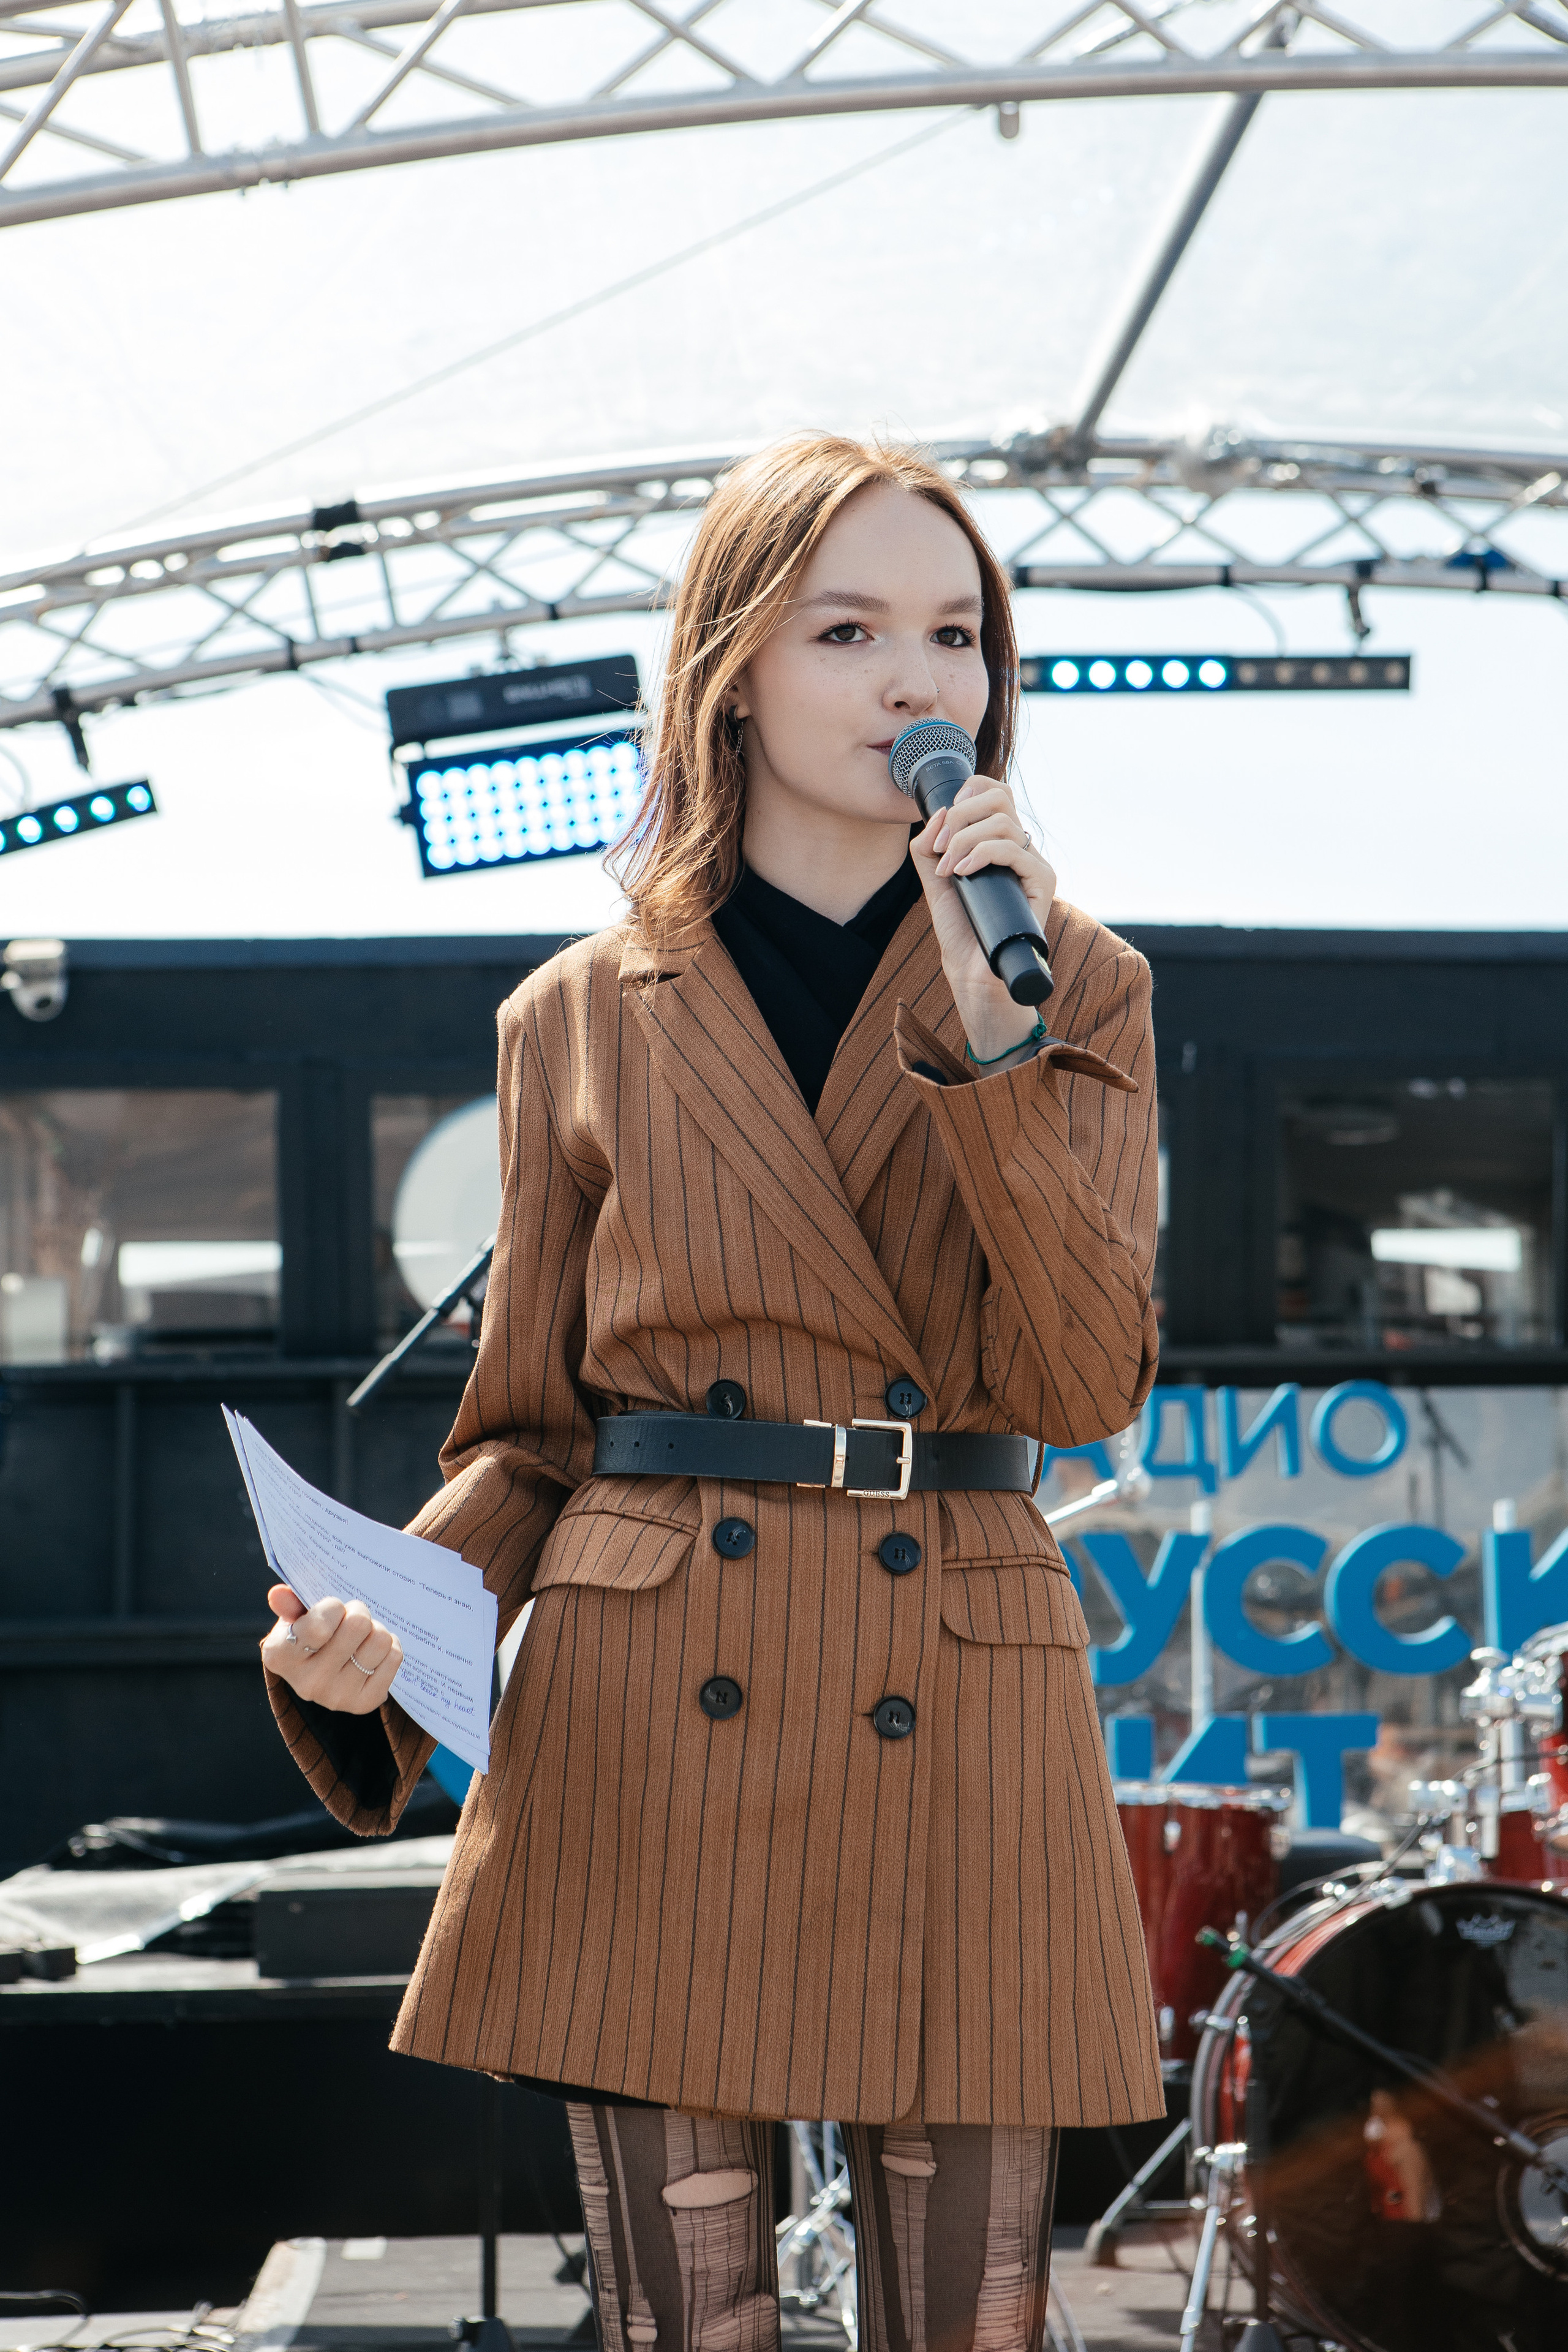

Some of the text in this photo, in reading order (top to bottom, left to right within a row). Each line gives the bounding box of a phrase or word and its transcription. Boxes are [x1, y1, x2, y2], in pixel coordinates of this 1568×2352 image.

[925, 762, 941, 772] BETA
[863, 1490, 890, 1498] GUESS
[357, 1551, 391, 1573] выложили
[392, 1570, 416, 1585] сторис
[1058, 1521, 1568, 1686] УССК
[374, 1610, 398, 1627] завтрак
[409, 1630, 435, 1649] корабле
[445, 1649, 473, 1667] конечно
[380, 1605, 391, 1615] что
[393, 1613, 405, 1623] оно
[412, 1624, 440, 1642] вправду
[399, 1667, 415, 1679] удет
[403, 1652, 463, 1689] ыступят участники
[448, 1687, 474, 1703] первым
[1105, 1711, 1379, 1829] ИТ
